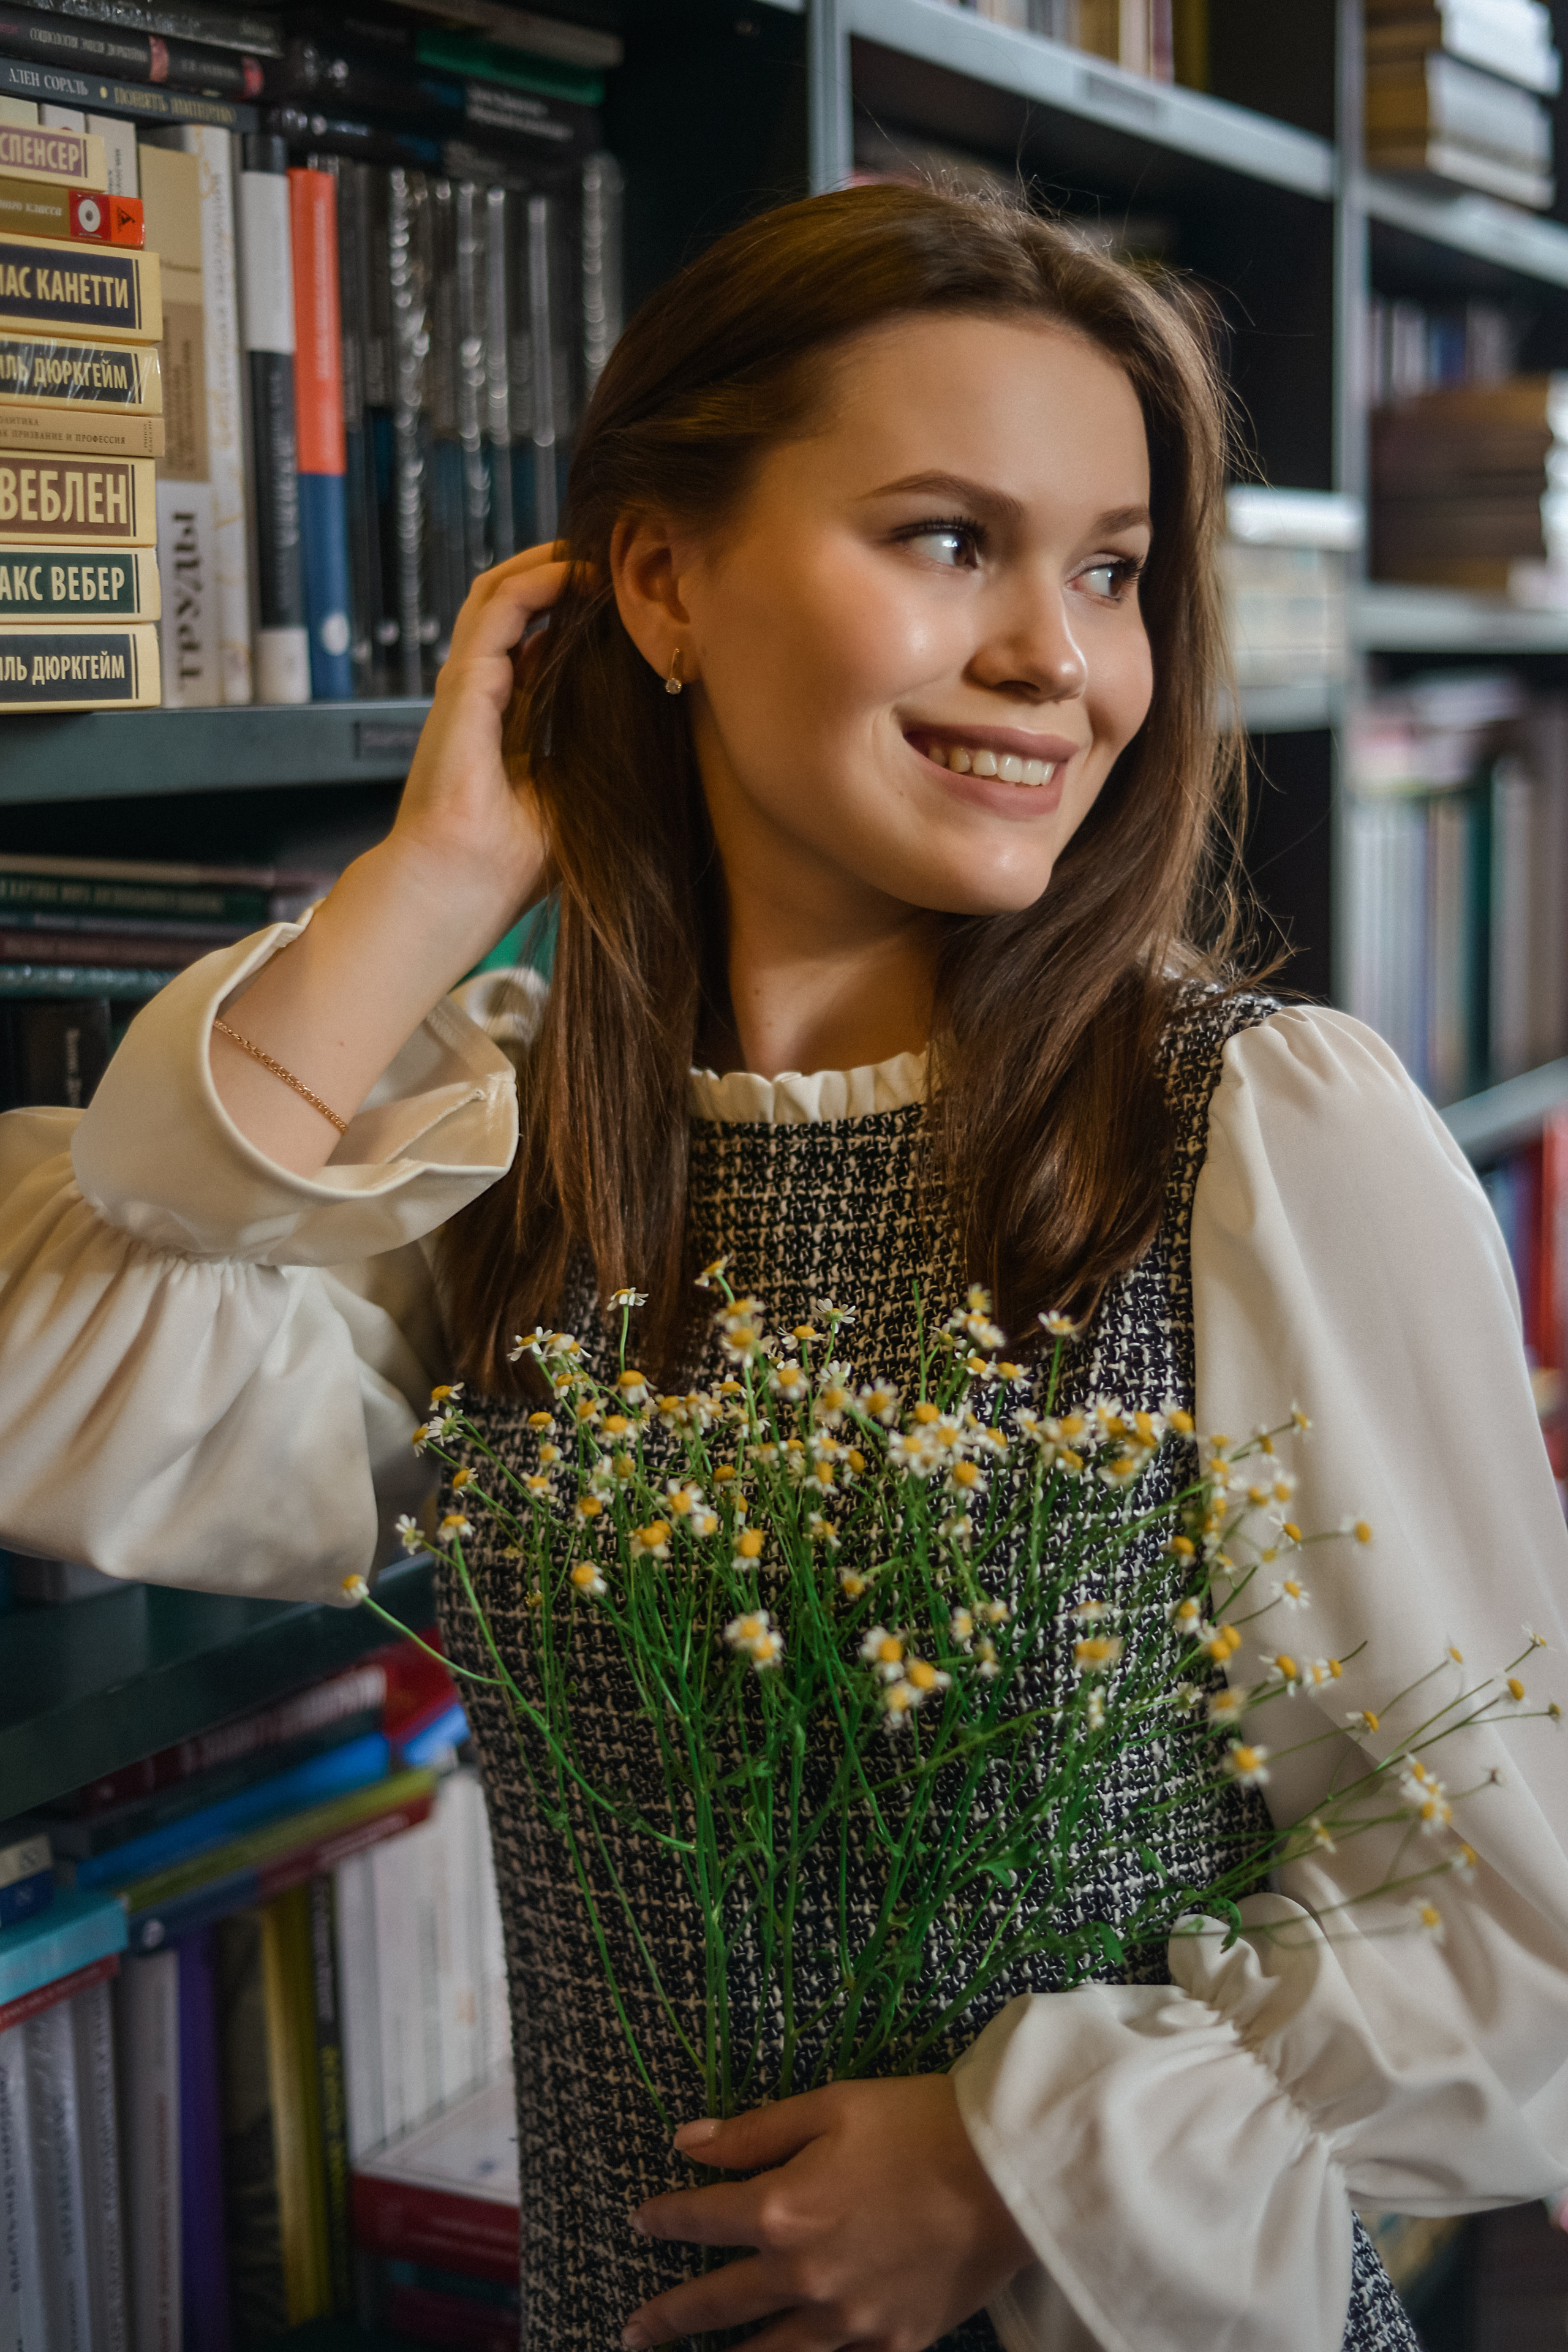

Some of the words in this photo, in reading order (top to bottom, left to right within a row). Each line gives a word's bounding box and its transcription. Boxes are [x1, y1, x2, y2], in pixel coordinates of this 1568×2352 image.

[9, 68, 40, 87] АЛЕН
[44, 75, 89, 96] СОРАЛЬ
[0, 132, 80, 172] СПЕНСЕР
[0, 263, 31, 298] АС
[36, 268, 129, 309] КАНЕТТИ
[34, 357, 128, 390] ДЮРКГЕЙМ
[12, 429, 62, 440] ПРИЗВАНИЕ
[75, 434, 126, 444] ПРОФЕССИЯ
[0, 467, 127, 524] ВЕБЛЕН
[0, 565, 43, 601] АКС
[51, 566, 125, 601] ВЕБЕР
[32, 650, 126, 685] ДЮРКГЕЙМ
